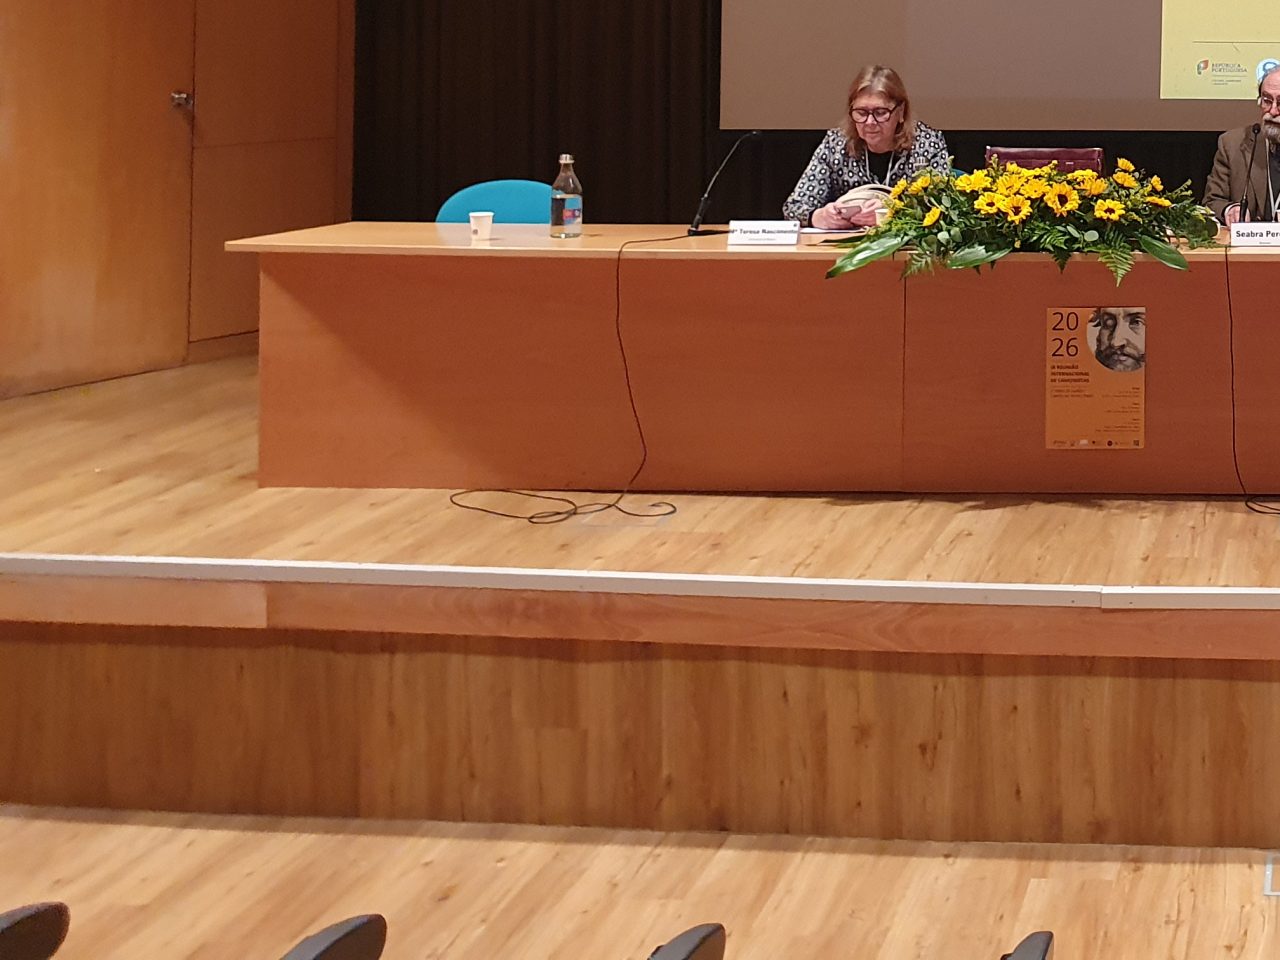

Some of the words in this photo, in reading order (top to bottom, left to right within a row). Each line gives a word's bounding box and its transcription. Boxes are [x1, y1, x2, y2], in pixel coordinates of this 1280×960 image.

[1235, 230, 1264, 238] Seabra
[1051, 312, 1079, 331] 20
[1051, 337, 1079, 357] 26
